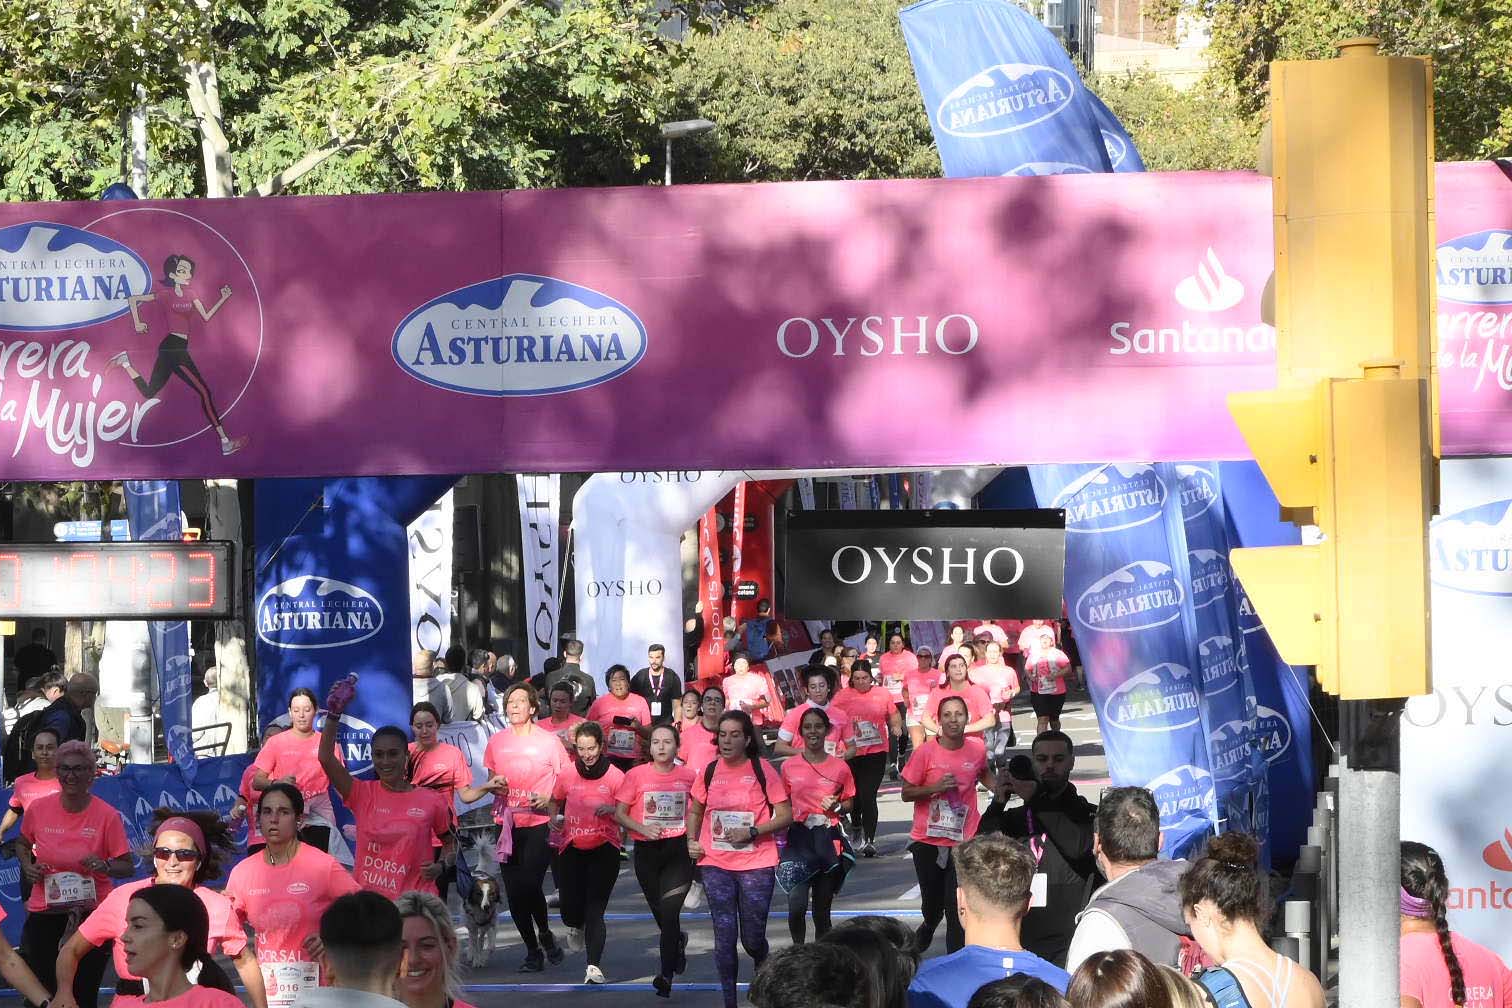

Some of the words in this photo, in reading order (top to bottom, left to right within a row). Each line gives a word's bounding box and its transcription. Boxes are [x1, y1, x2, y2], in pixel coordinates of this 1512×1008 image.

[54, 257, 127, 270] LECHERA
[451, 316, 529, 330] CENTRAL
[538, 314, 618, 328] LECHERA
[412, 321, 627, 367] ASTURIANA
[776, 312, 980, 360] OYSHO
[1459, 345, 1477, 368] la
[12, 374, 161, 468] Mujer
[522, 474, 554, 650] OYSH
[832, 545, 1025, 586] OYSHO
[1435, 538, 1512, 572] ASTU
[587, 579, 662, 599] OYSHO
[274, 600, 317, 610] CENTRAL
[321, 599, 371, 609] LECHERA
[262, 605, 375, 633] ASTURIANA
[364, 855, 406, 876] DORSA
[362, 870, 397, 889] SUMA
[279, 983, 299, 992] 016
